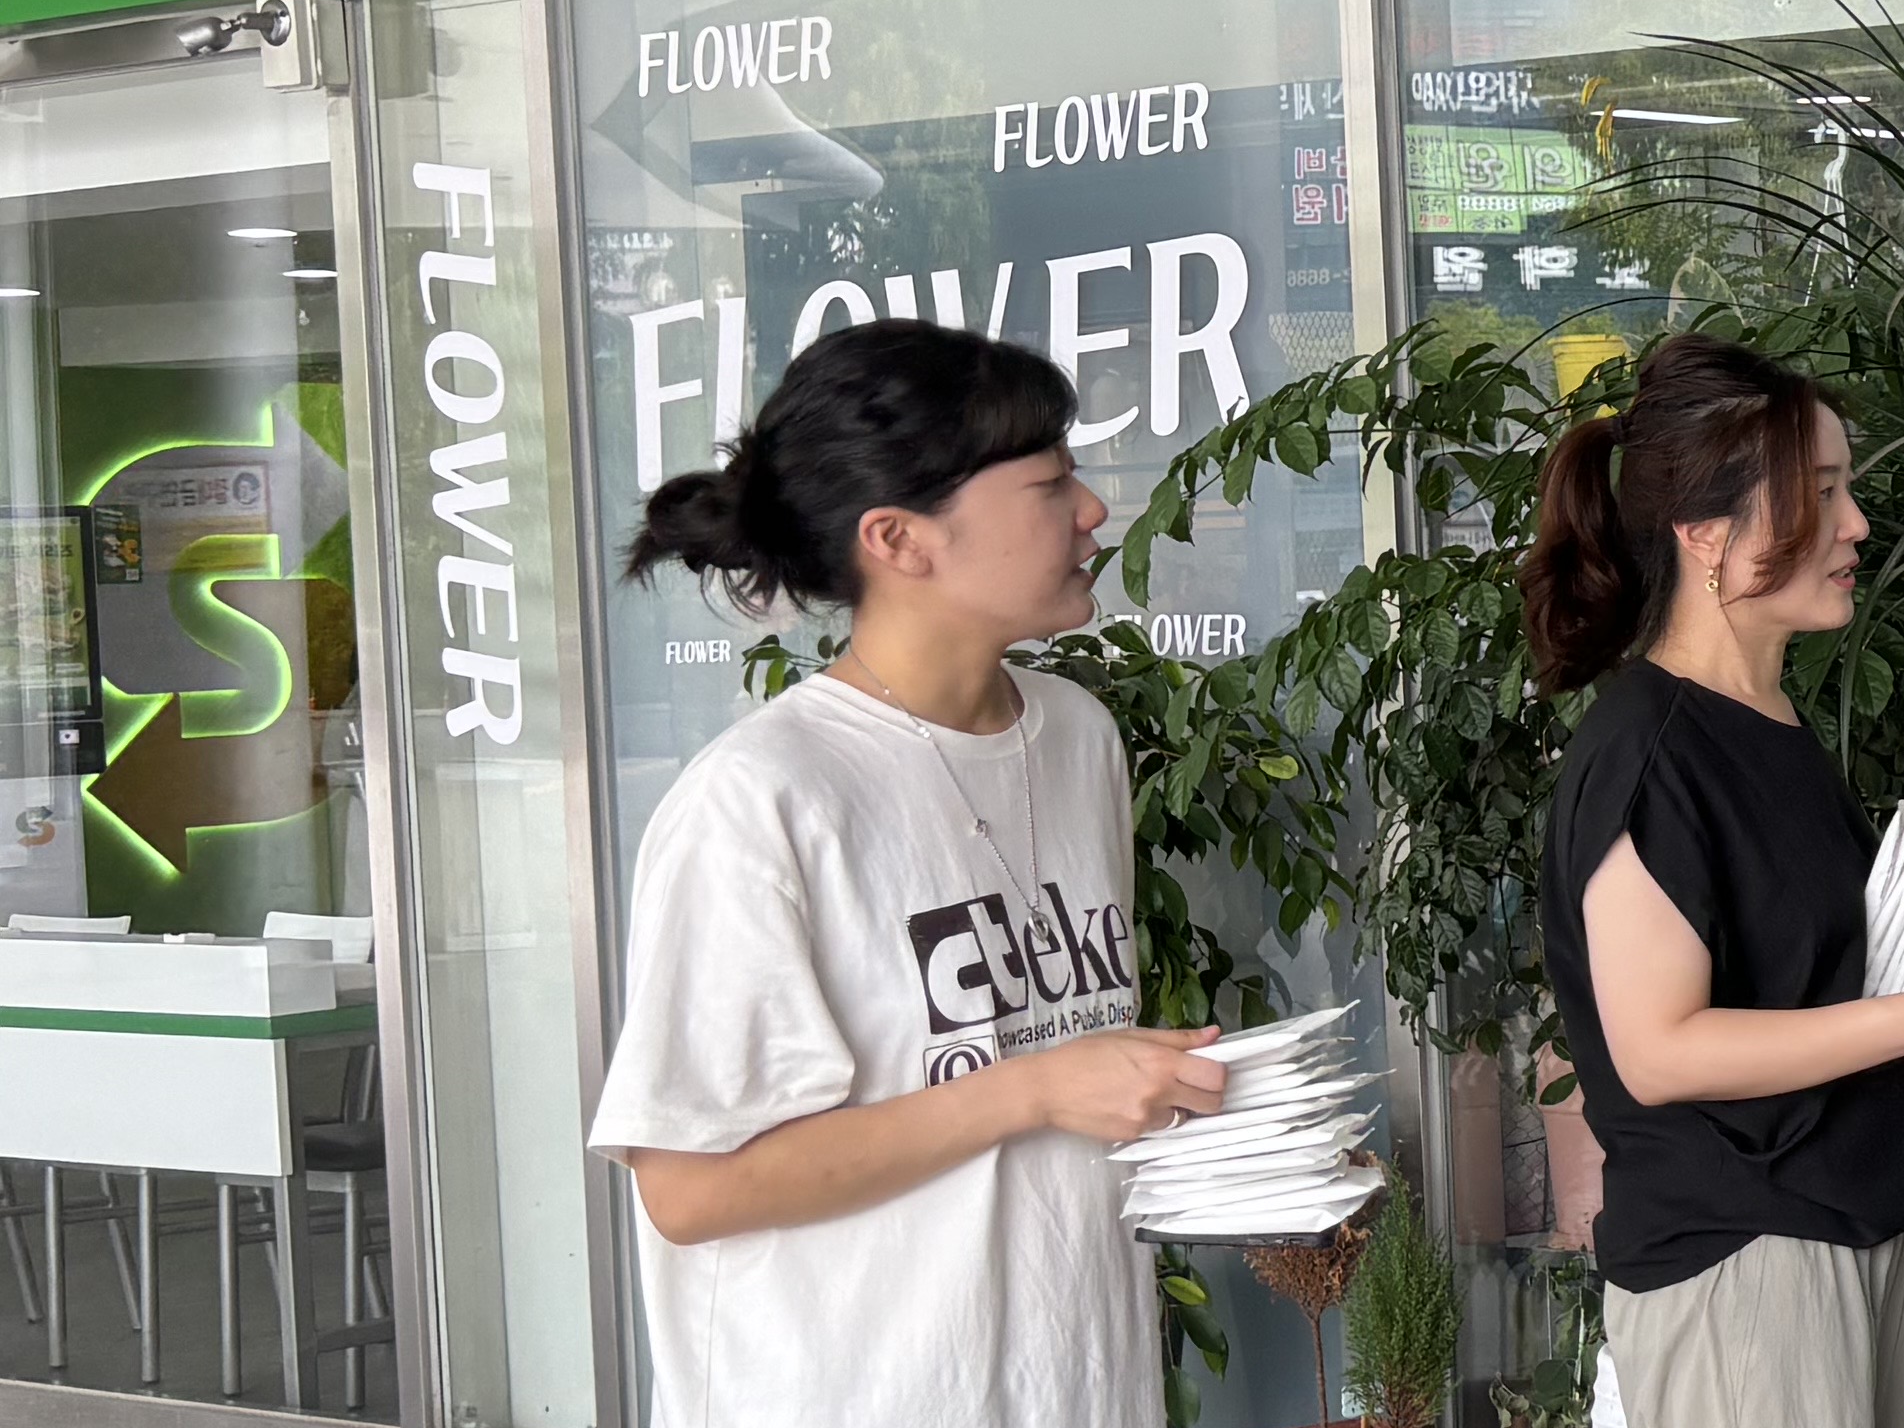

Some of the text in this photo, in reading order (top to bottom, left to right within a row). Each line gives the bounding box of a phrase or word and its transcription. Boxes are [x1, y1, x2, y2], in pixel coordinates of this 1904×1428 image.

[638, 16, 833, 97] FLOWER
[992, 82, 1210, 173] FLOWER
[629, 232, 1250, 493] FLER
[413, 161, 525, 745] FLOWER
[664, 638, 731, 665] FLOWER
[1114, 613, 1247, 657] OWER
[1060, 1012, 1071, 1036] A
